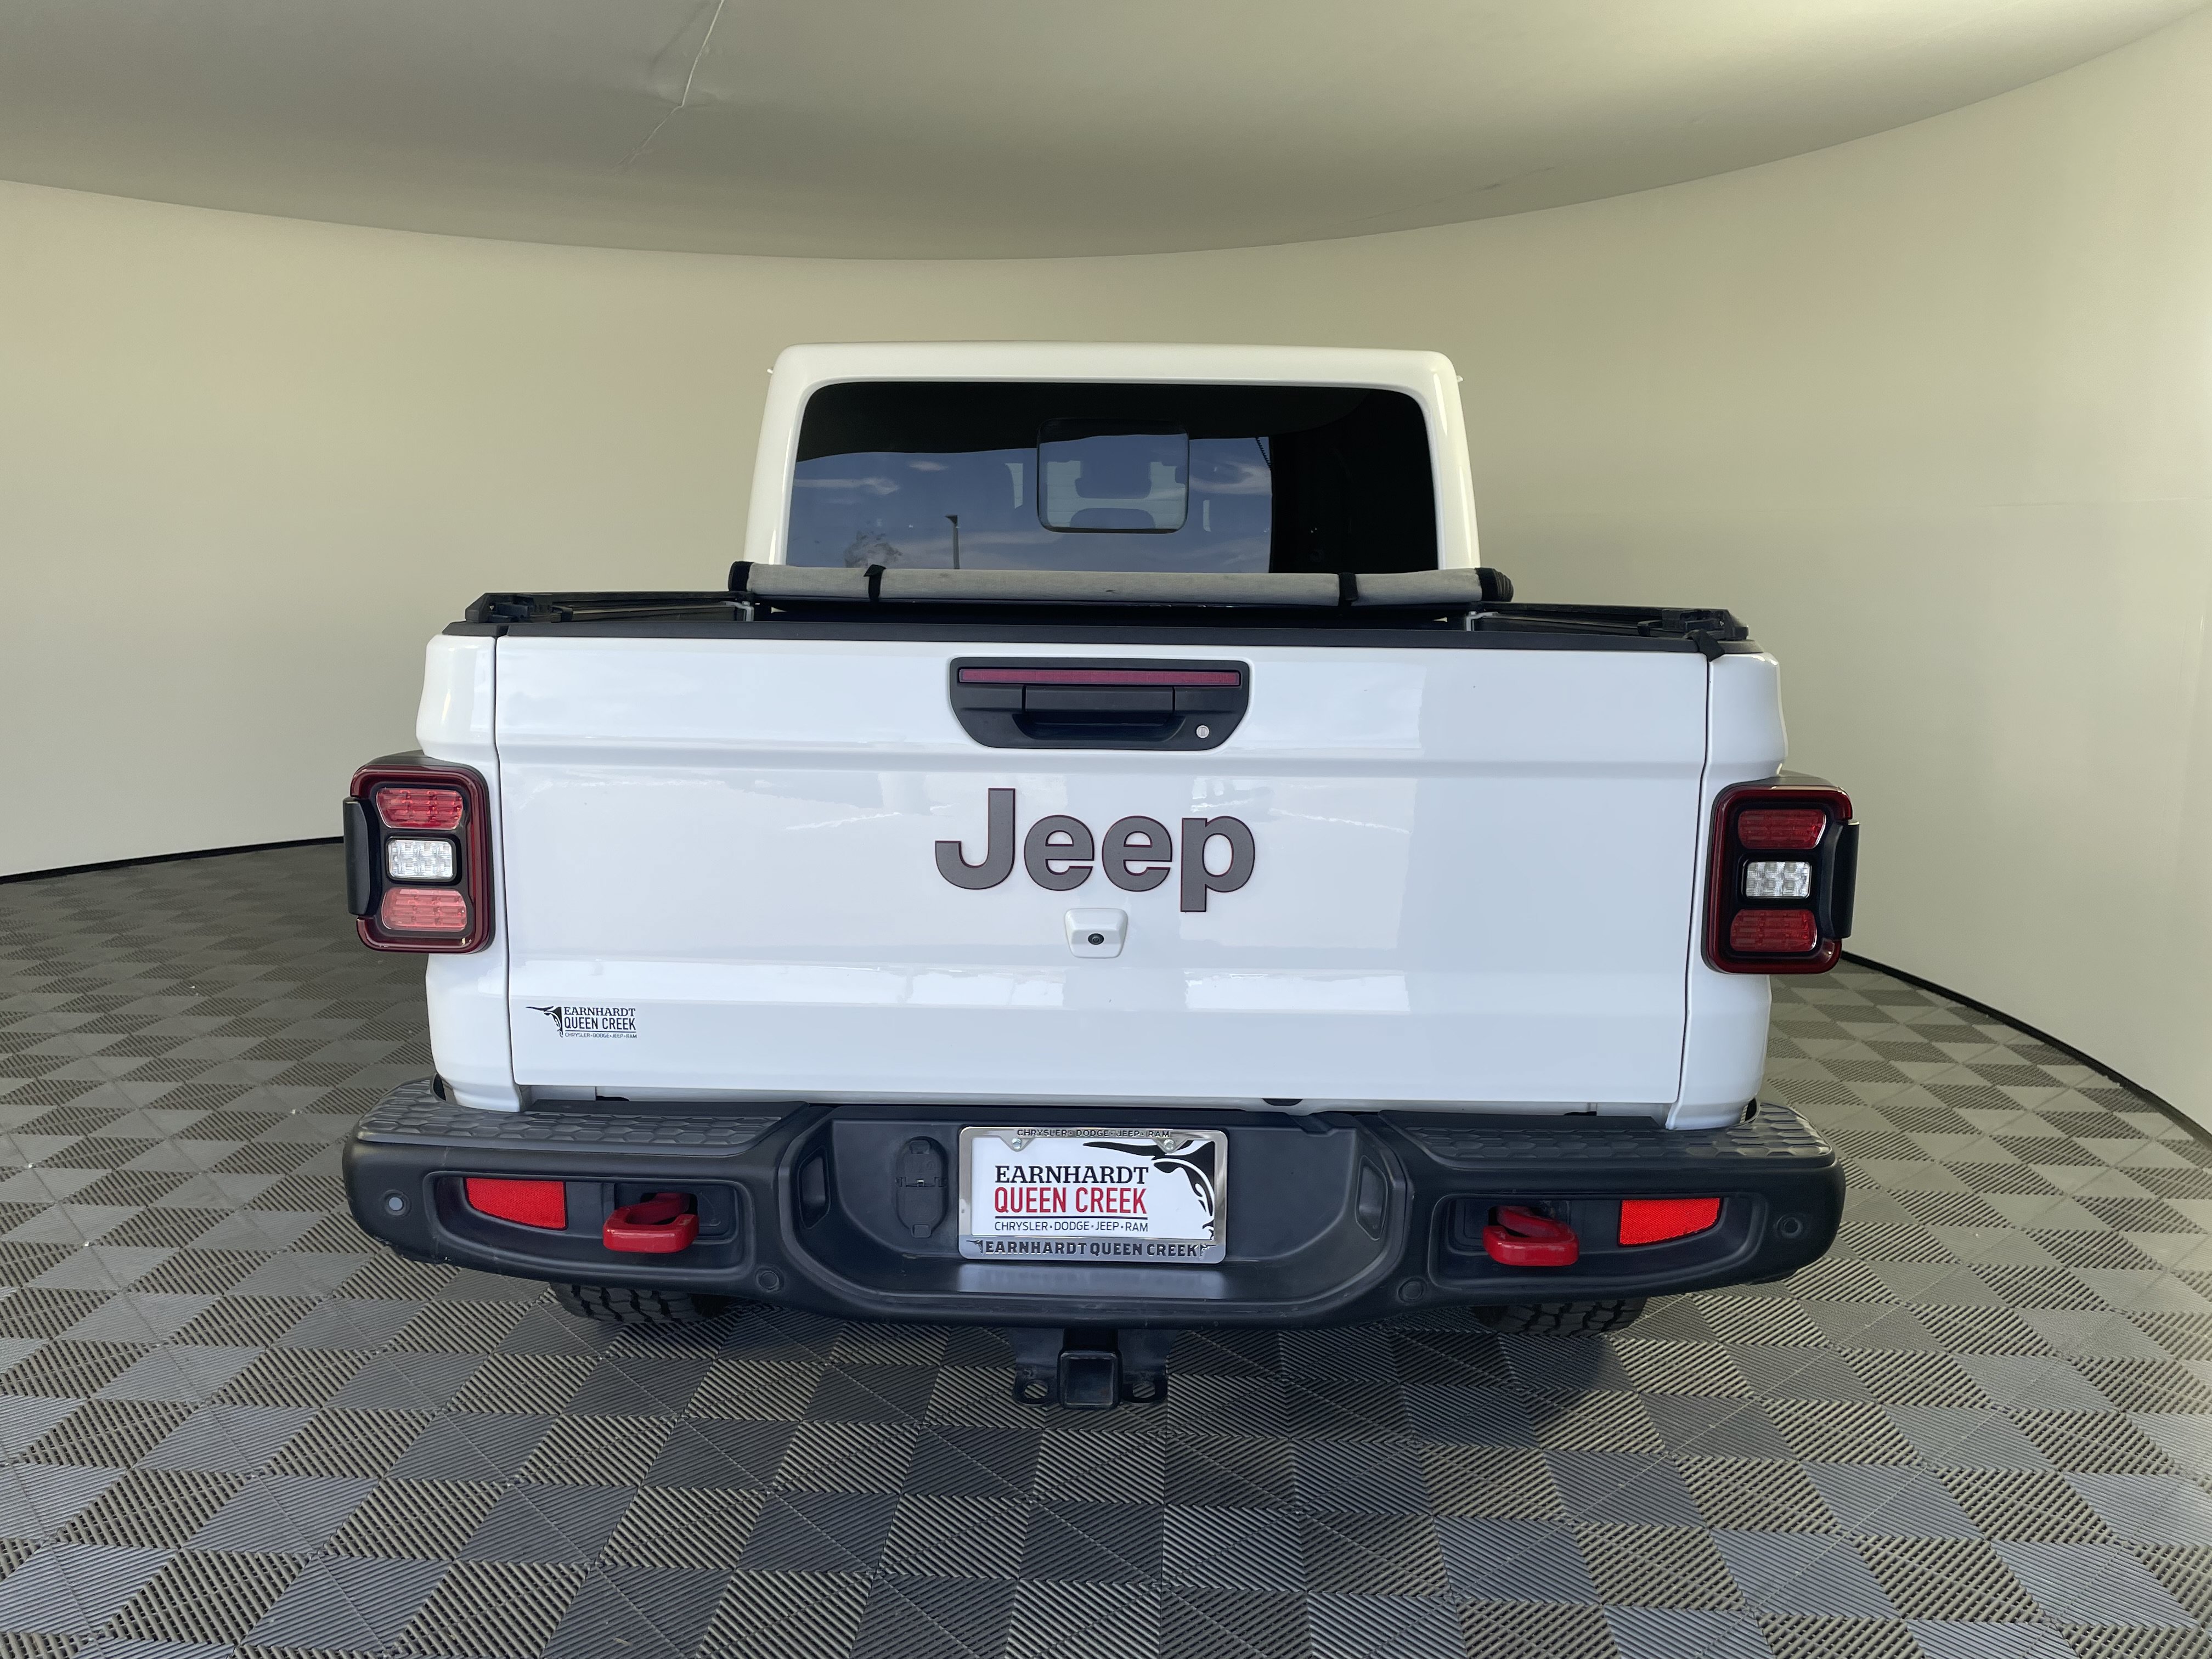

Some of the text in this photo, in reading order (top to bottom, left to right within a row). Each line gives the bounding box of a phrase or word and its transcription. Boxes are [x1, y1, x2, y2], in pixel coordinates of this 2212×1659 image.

[935, 788, 1255, 912] Jeep
[563, 1007, 636, 1017] EARNHARDT
[564, 1017, 636, 1030] QUEEN CREEK
[995, 1165, 1149, 1184] EARNHARDT
[994, 1187, 1147, 1214] QUEEN CREEK
[985, 1240, 1197, 1257] EARNHARDT QUEEN CREEK
